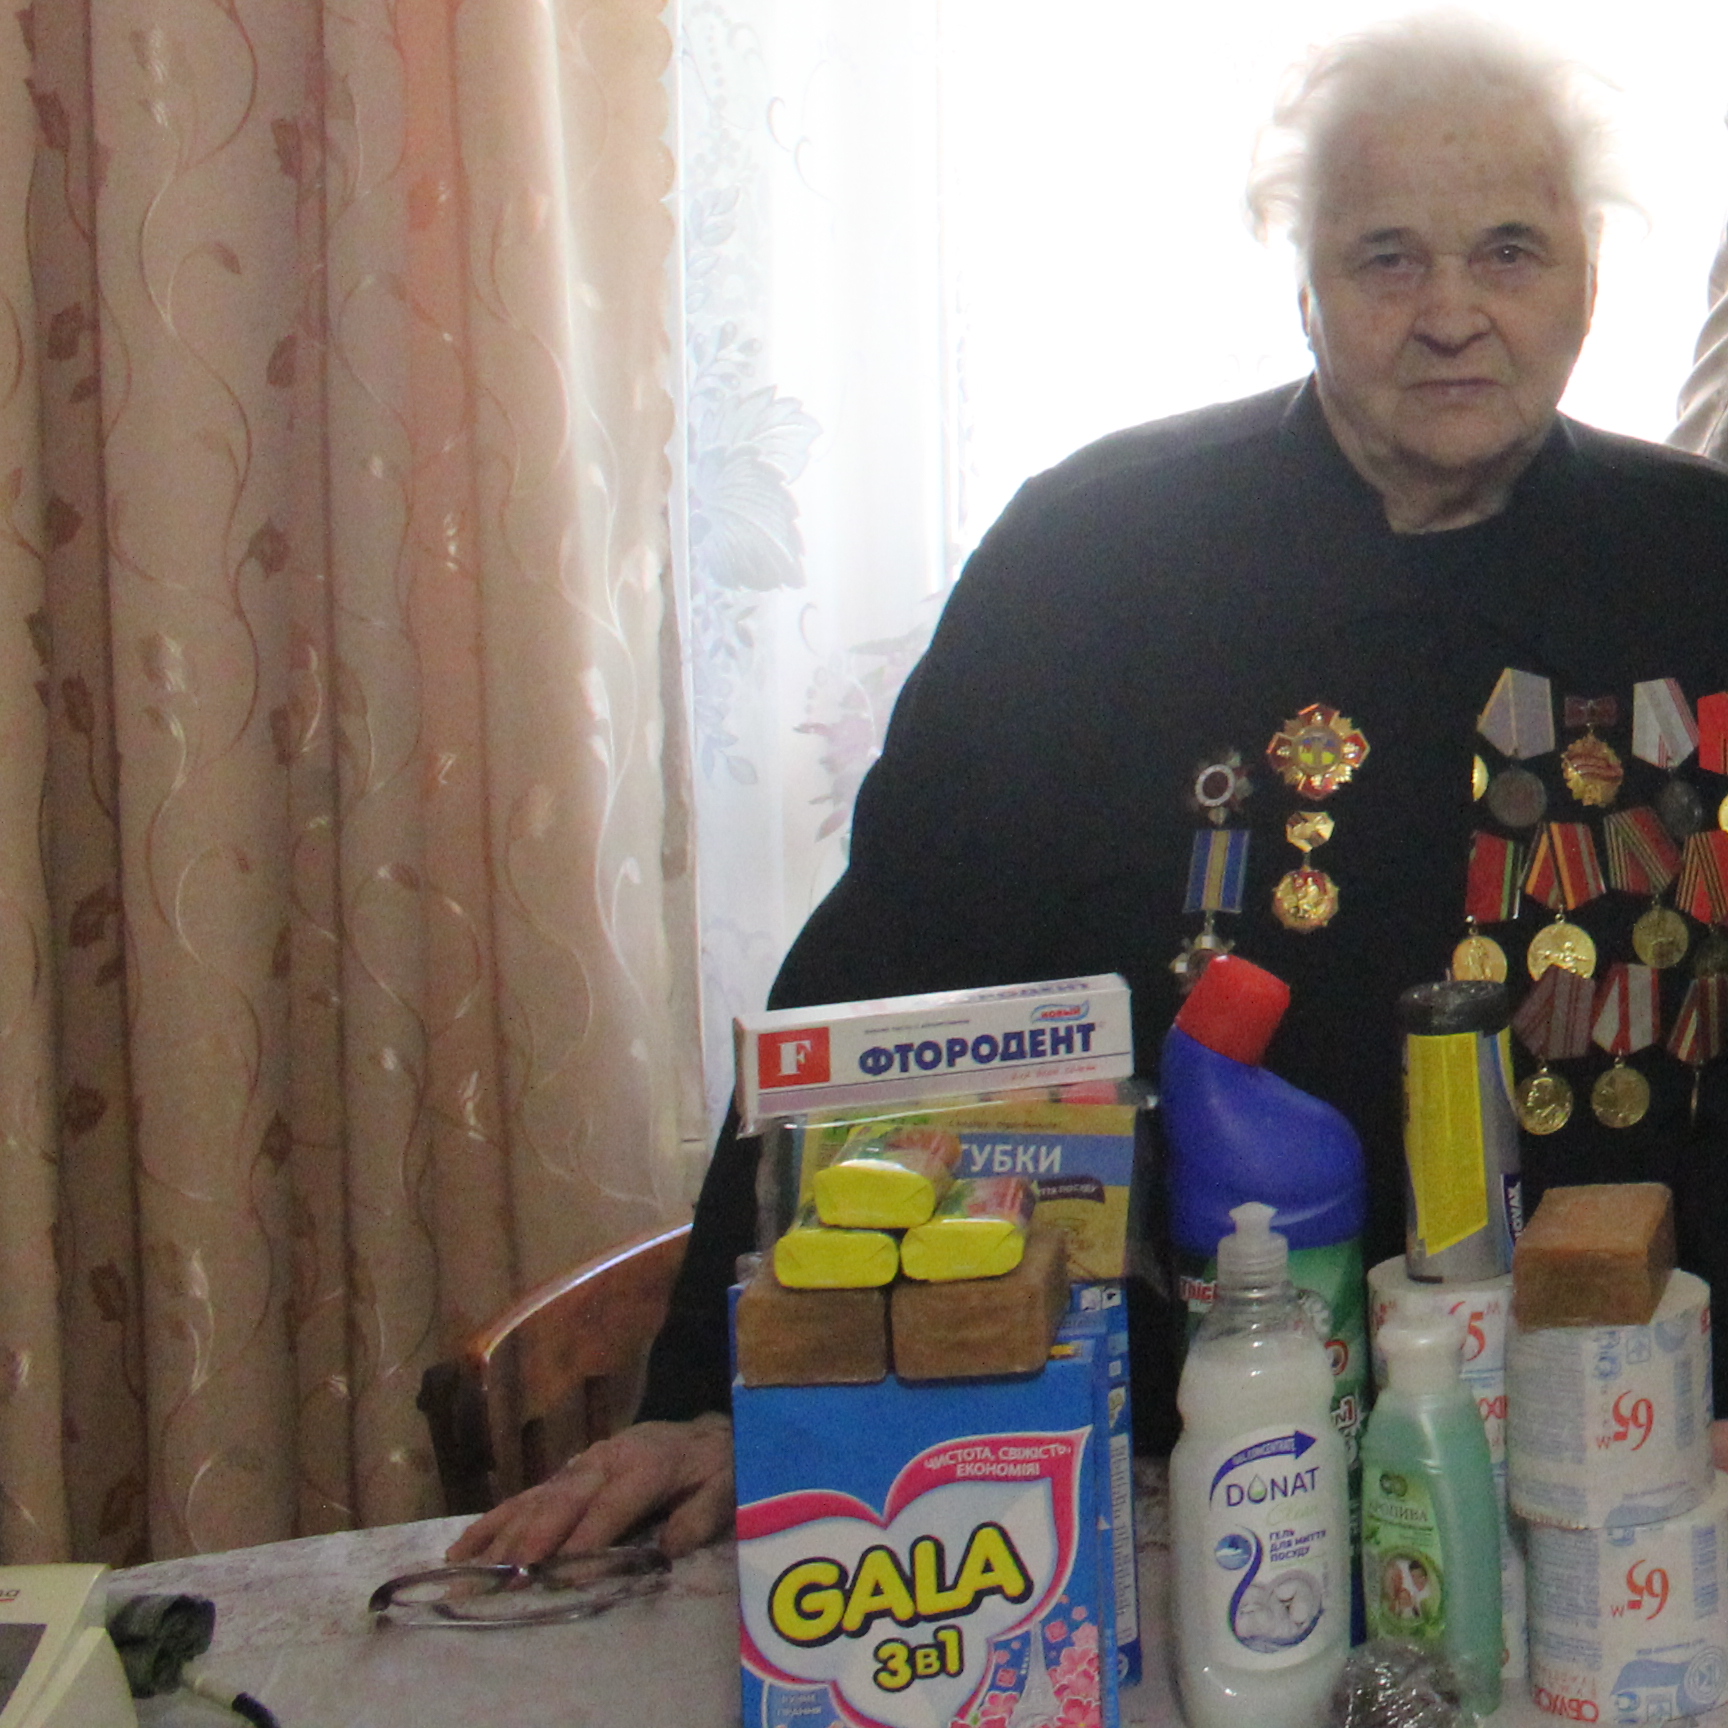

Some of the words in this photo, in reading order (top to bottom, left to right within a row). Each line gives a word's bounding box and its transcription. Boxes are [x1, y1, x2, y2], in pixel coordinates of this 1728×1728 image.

[777, 1039, 812, 1076] F
[858, 1022, 1096, 1077] ФТОРОДЕНТ
[924, 1446, 995, 1470] ЧИСТОТА,
[955, 1462, 1041, 1478] ЕКОНОМІЯ!
[1226, 1467, 1320, 1507] DONAT
[769, 1522, 1033, 1648] GALA
